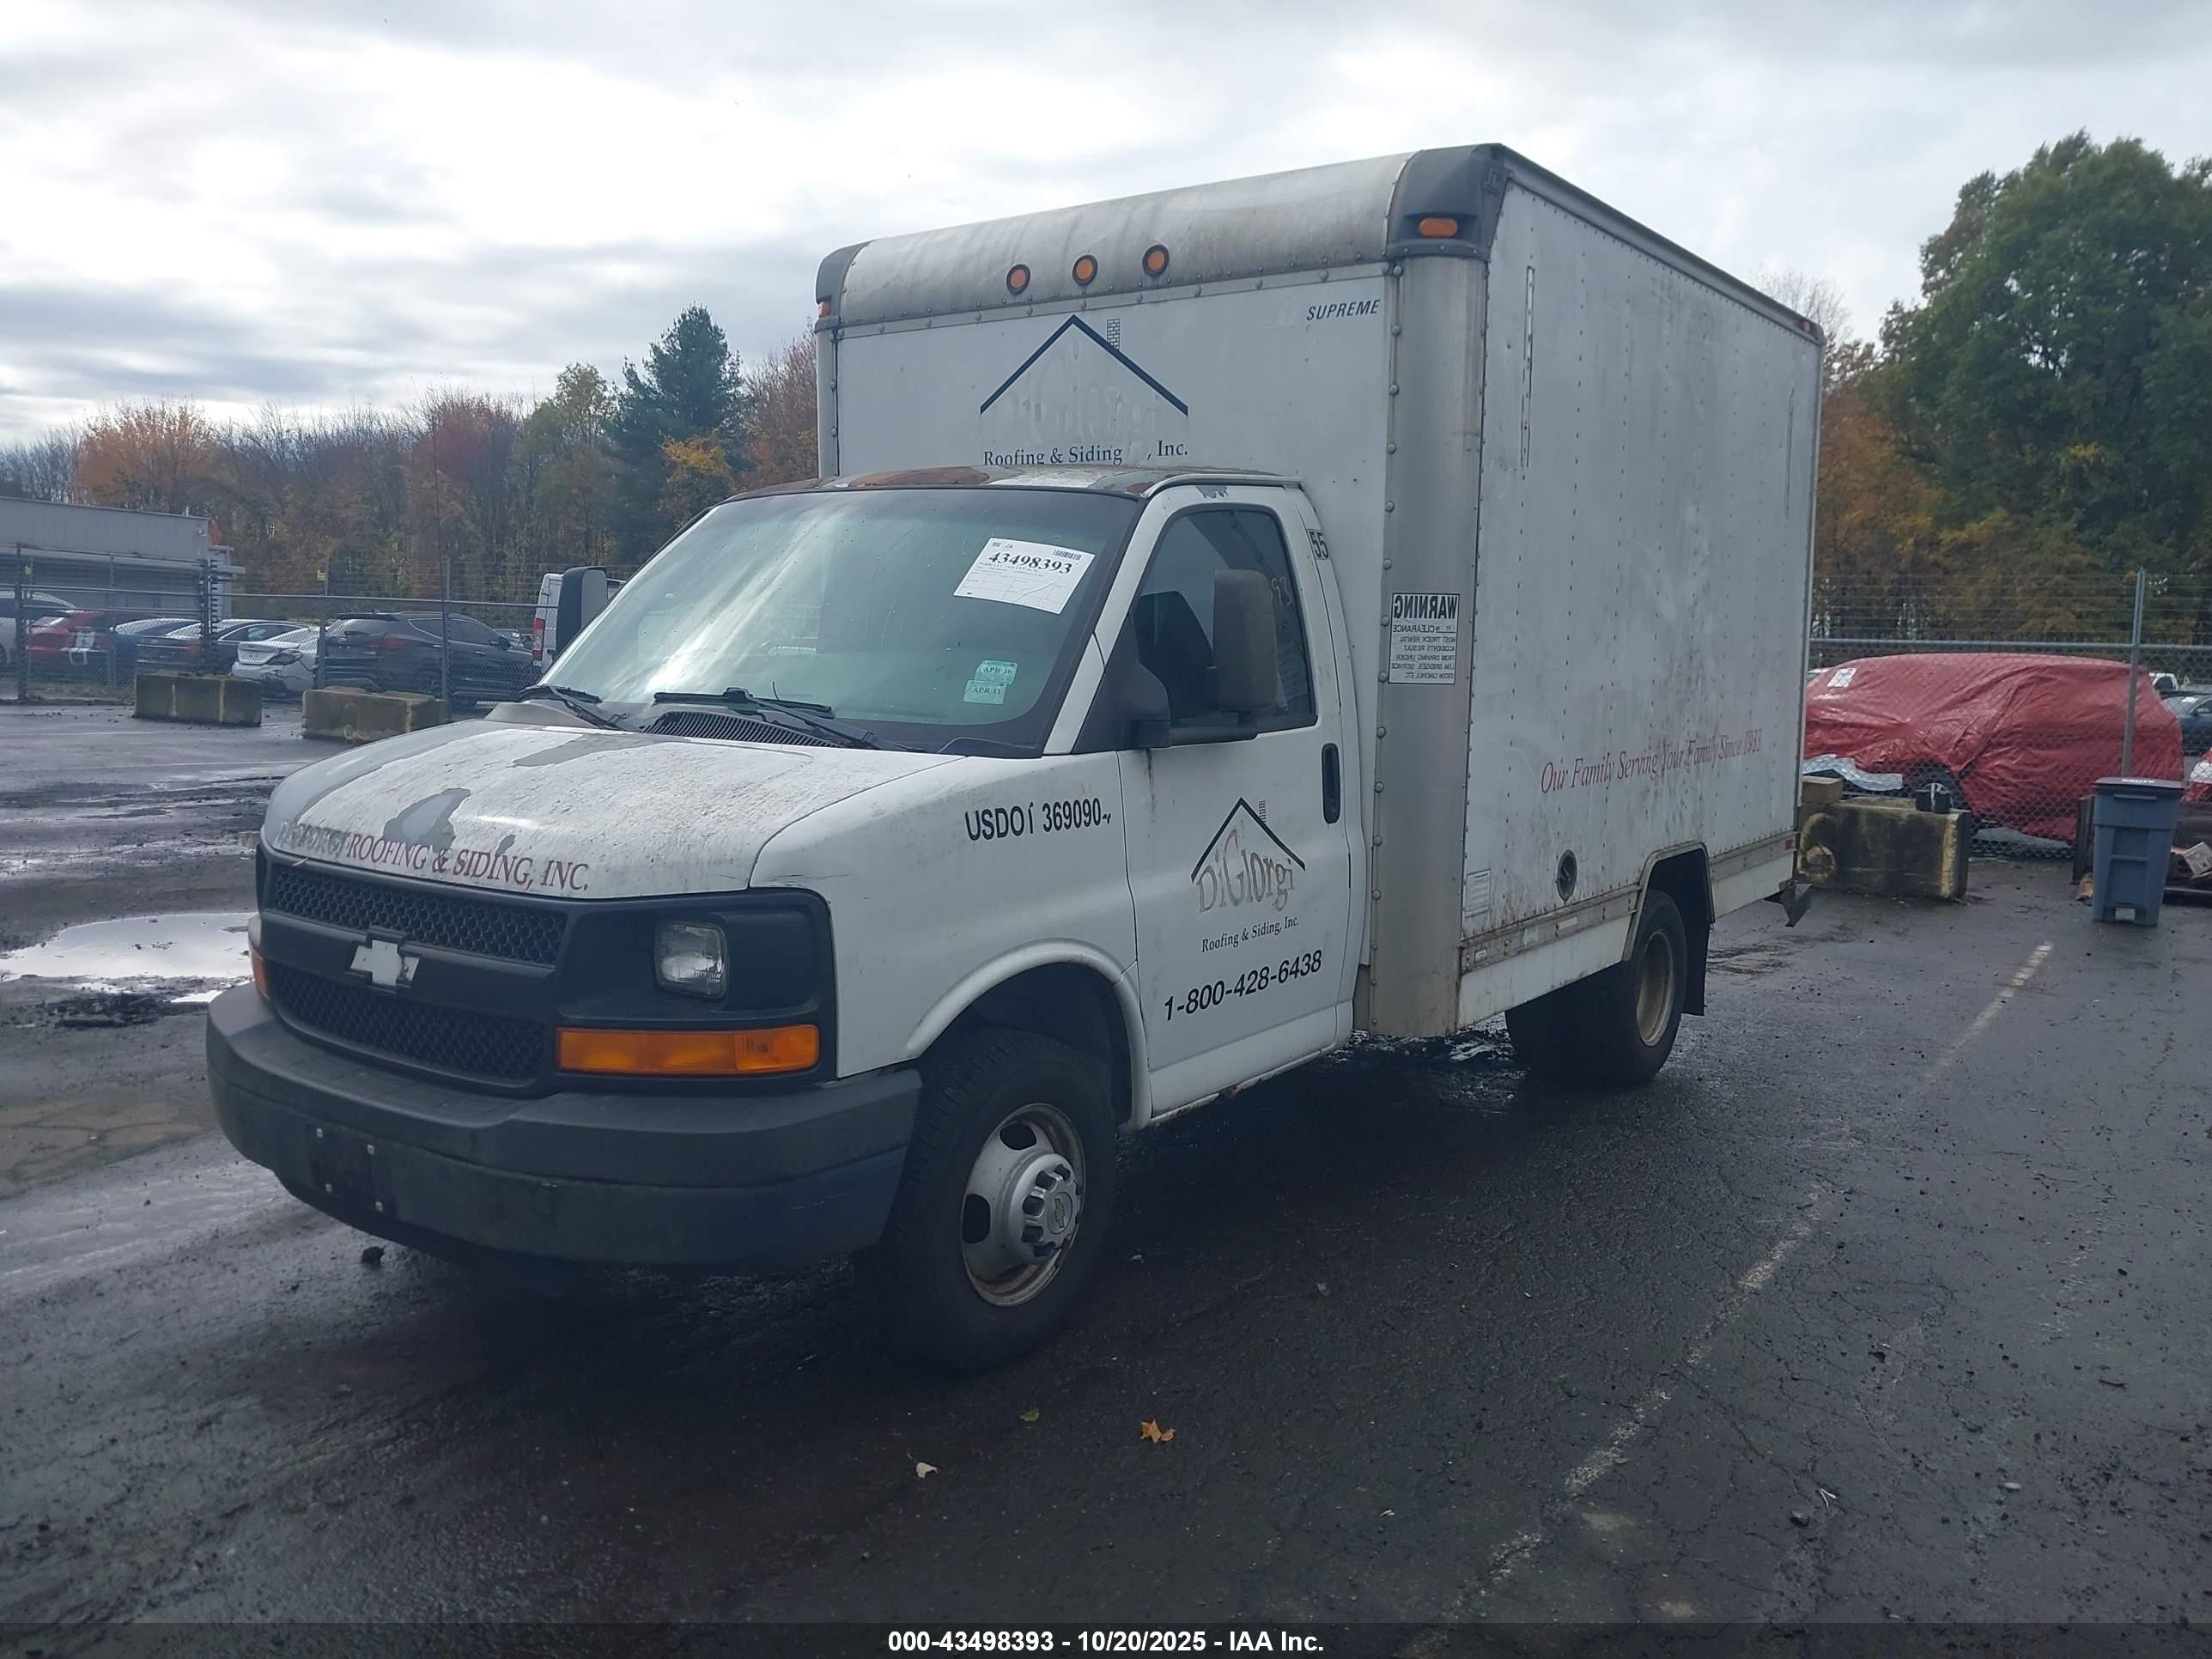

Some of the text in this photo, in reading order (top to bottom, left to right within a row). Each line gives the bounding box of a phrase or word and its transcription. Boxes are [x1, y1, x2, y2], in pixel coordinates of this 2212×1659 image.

[1306, 299, 1381, 321] SUPREME
[983, 449, 1045, 465] Roofing
[1049, 447, 1064, 464] &
[1157, 440, 1188, 457] Inc.
[1309, 532, 1330, 559] 55
[988, 551, 1073, 575] 43498393
[1540, 762, 1569, 794] Our
[1571, 751, 1614, 789] Family
[1617, 750, 1658, 781] Serving
[1661, 741, 1685, 772] Your
[1686, 736, 1717, 769] Family
[1717, 734, 1741, 760] Since
[345, 834, 427, 871] ROOFING
[430, 848, 453, 873] &
[453, 848, 533, 891] SIDING,
[539, 860, 589, 891] INC.
[1201, 915, 1299, 953] Roofing & Siding, Inc.
[1164, 949, 1322, 1022] 1-800-428-6438
